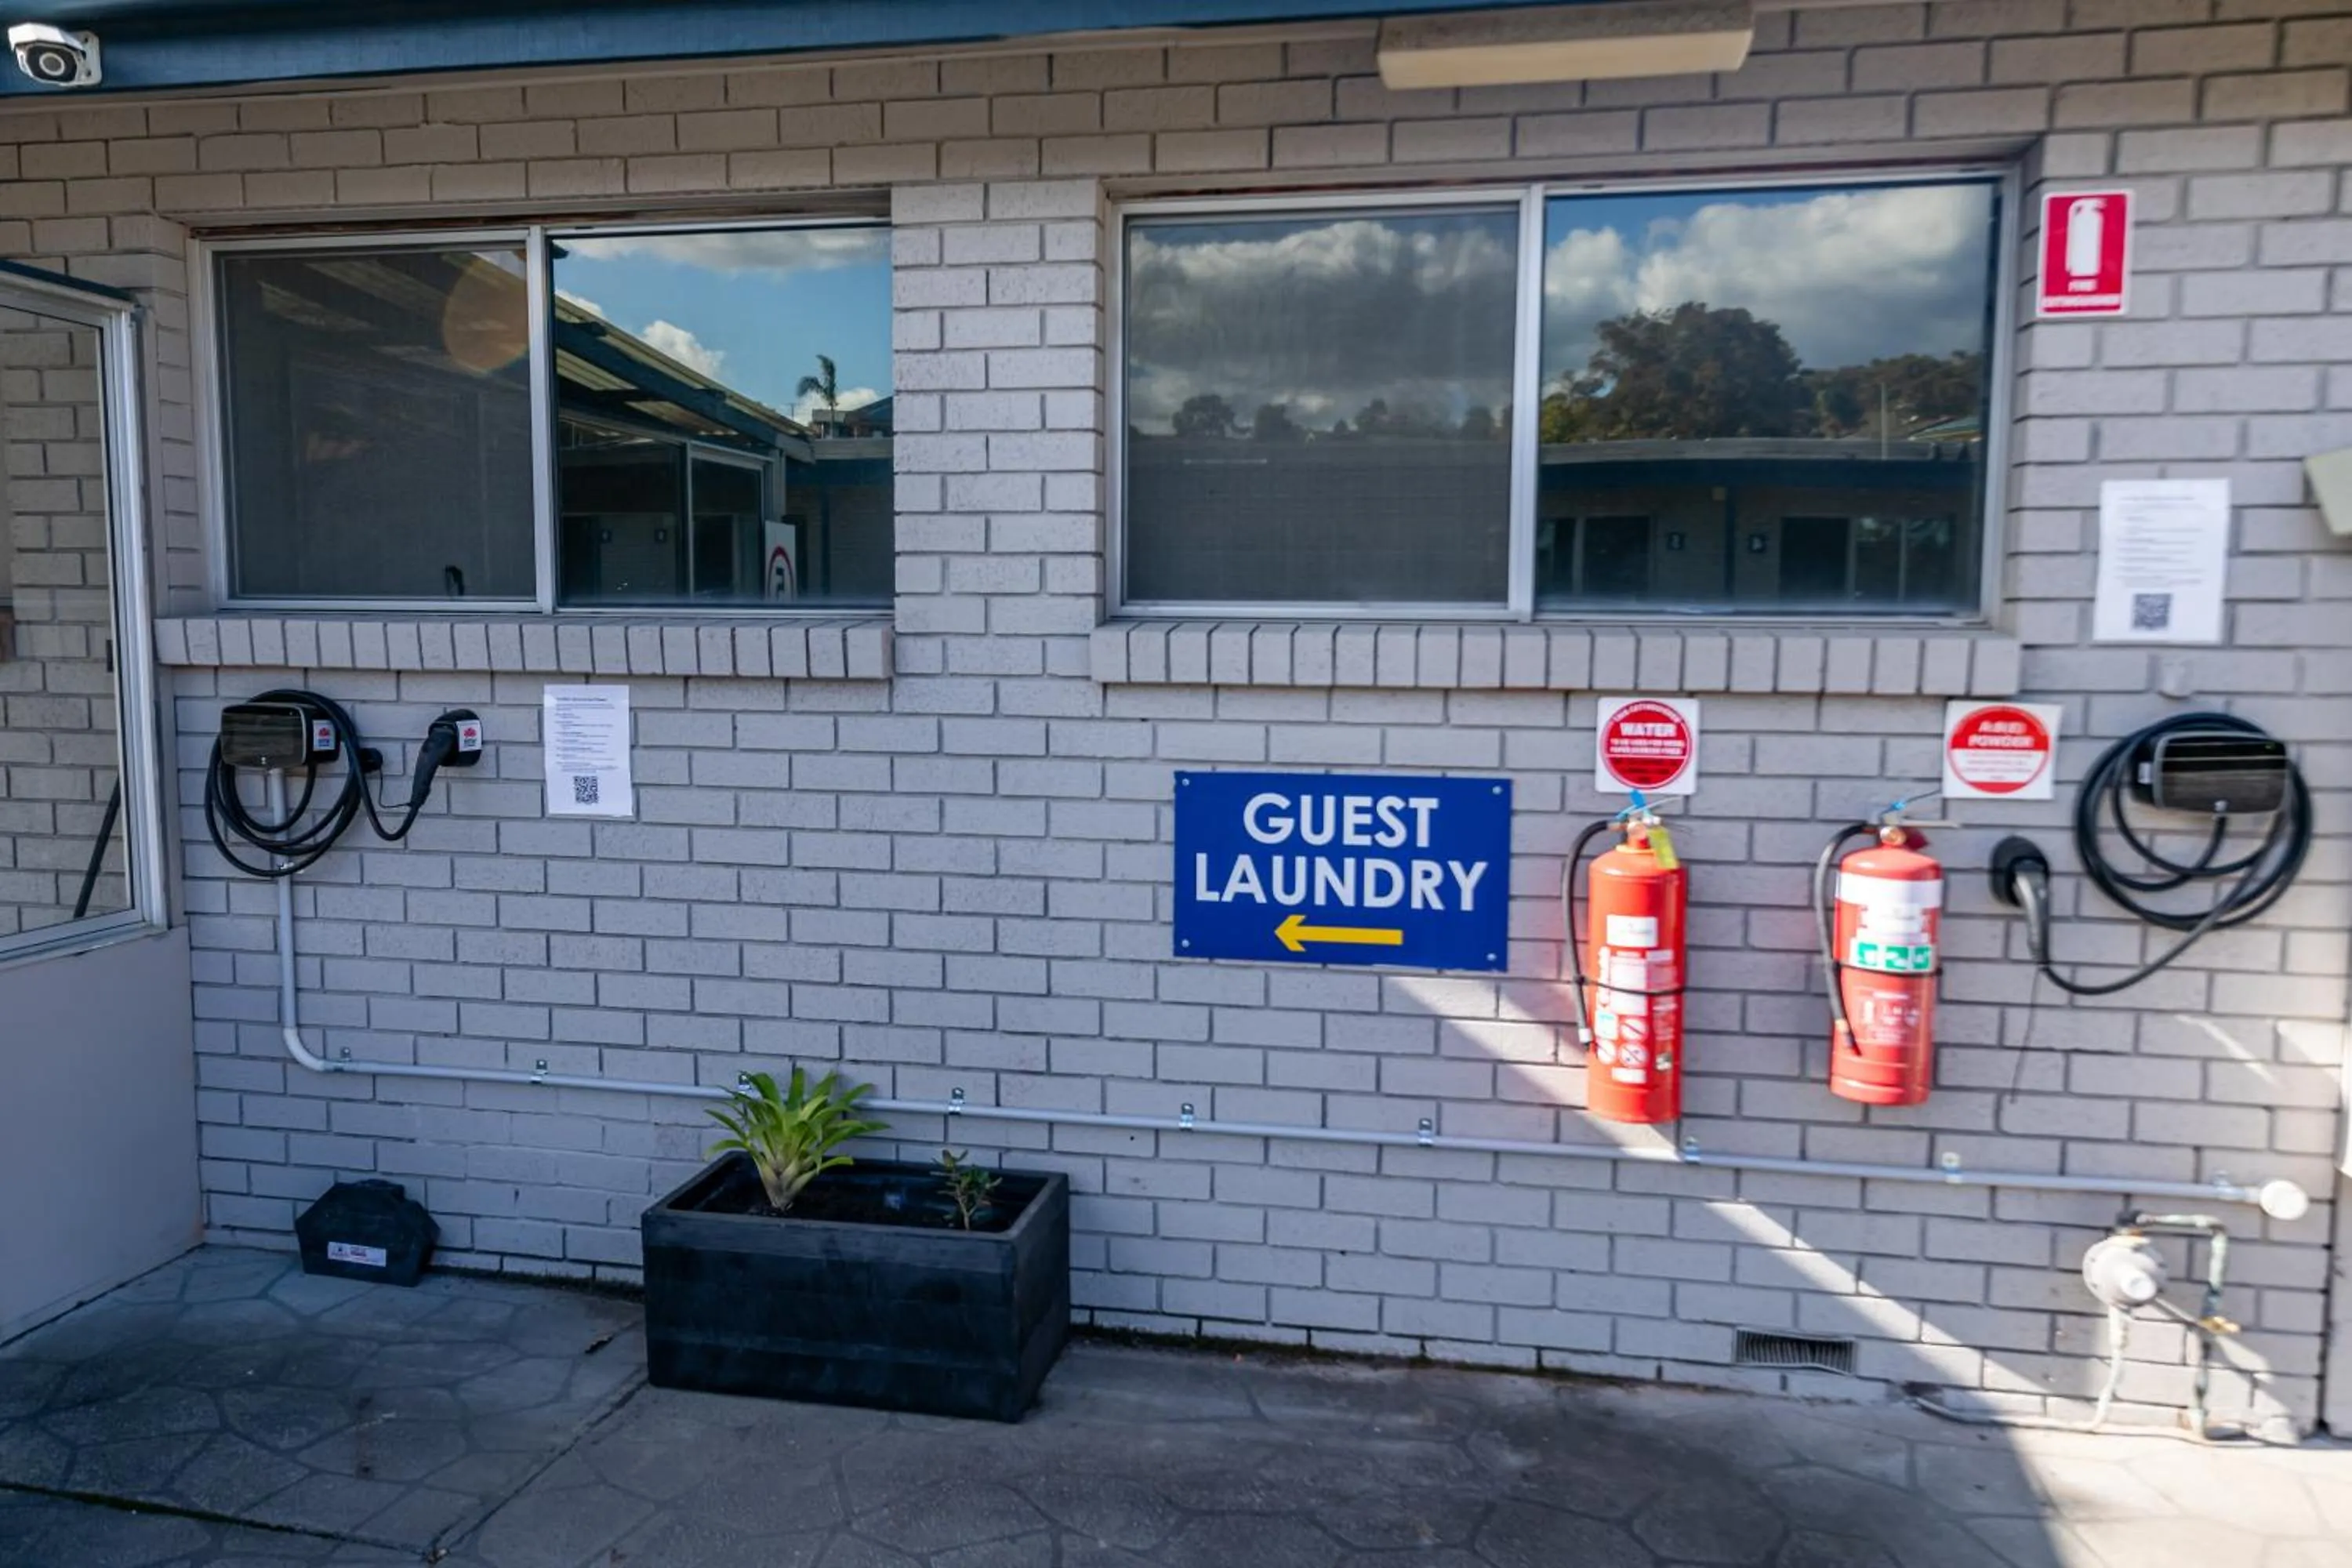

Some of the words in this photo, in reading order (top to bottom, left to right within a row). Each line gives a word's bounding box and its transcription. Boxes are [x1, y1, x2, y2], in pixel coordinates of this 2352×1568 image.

[1620, 722, 1677, 737] WATER
[1243, 792, 1439, 848] GUEST
[1195, 852, 1487, 911] LAUNDRY
